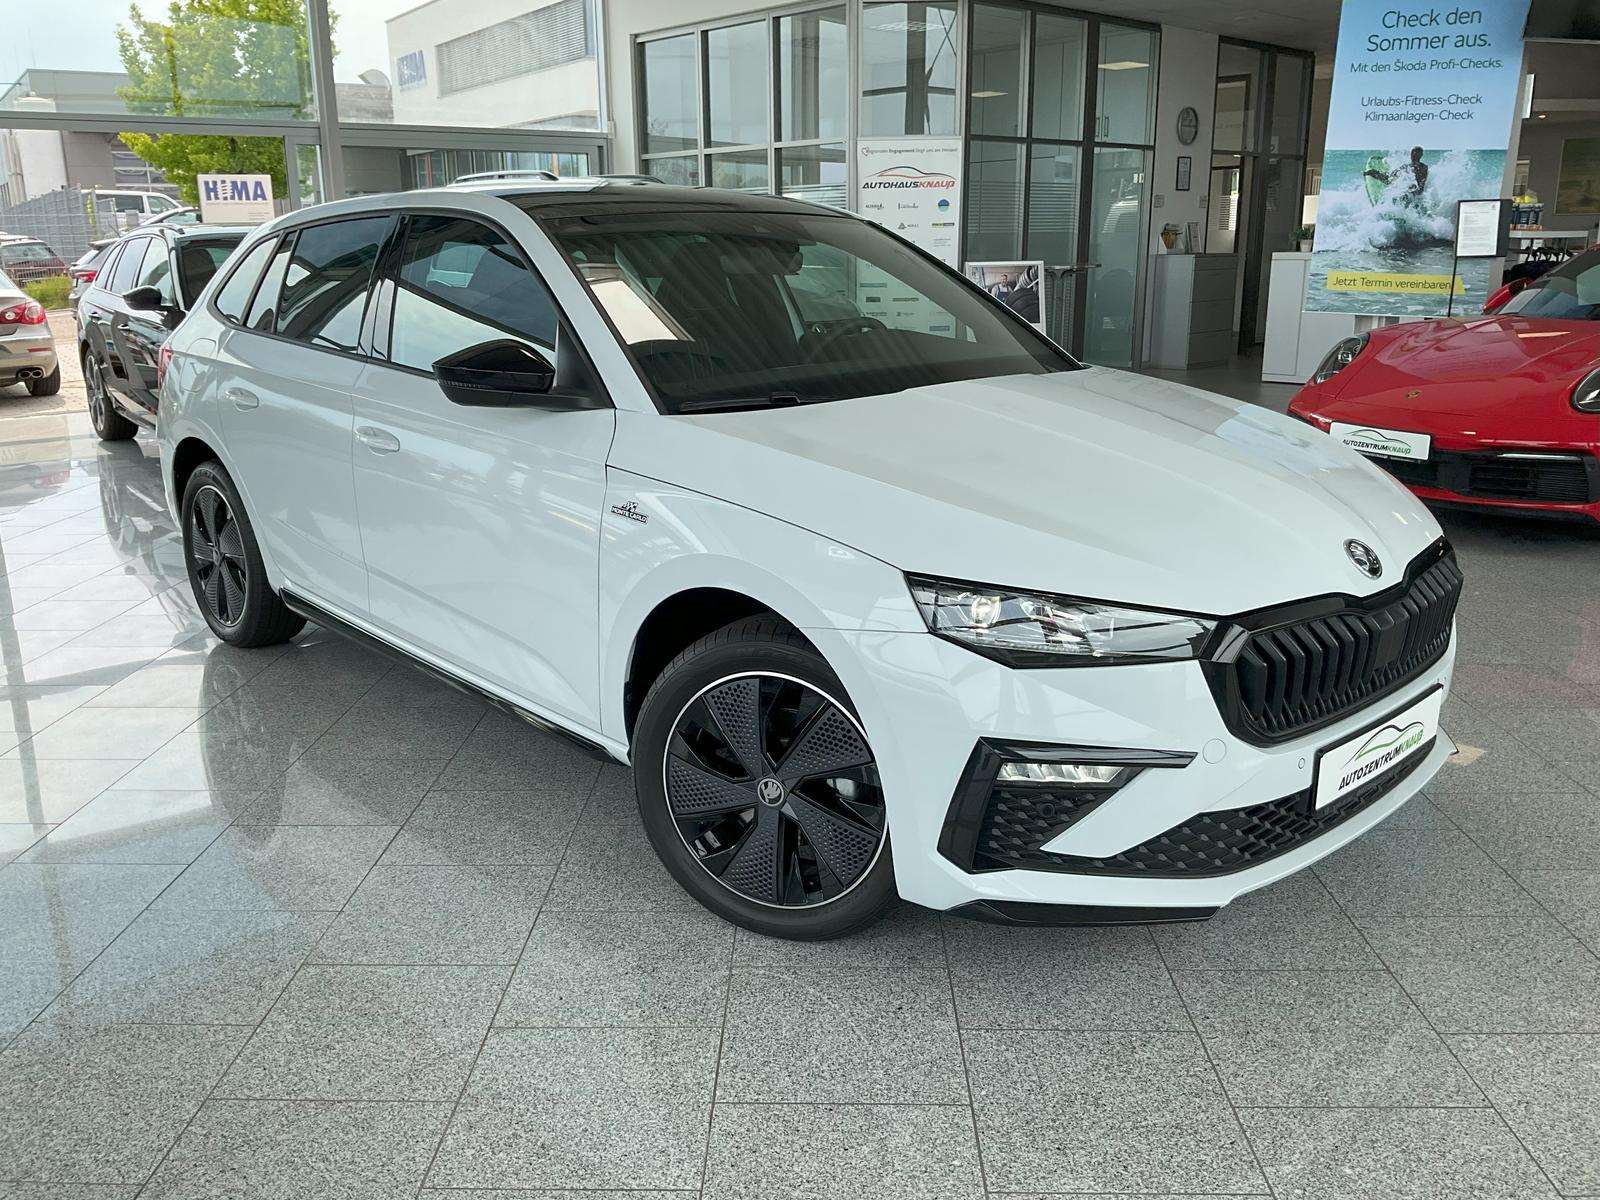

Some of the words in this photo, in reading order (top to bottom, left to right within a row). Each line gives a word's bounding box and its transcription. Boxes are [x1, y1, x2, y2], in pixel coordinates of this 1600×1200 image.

[1382, 9, 1441, 29] Check
[1446, 7, 1482, 25] den
[1367, 34, 1450, 52] Sommer
[1454, 33, 1492, 48] aus.
[1350, 62, 1369, 73] Mit
[1371, 62, 1391, 72] den
[1394, 59, 1427, 71] Škoda
[1430, 57, 1504, 70] Profi-Checks.
[1361, 94, 1484, 107] Urlaubs-Fitness-Check
[1365, 109, 1474, 123] Klimaanlagen-Check
[203, 179, 268, 201] HIMA
[1333, 276, 1357, 287] Jetzt
[1360, 277, 1393, 288] Termin
